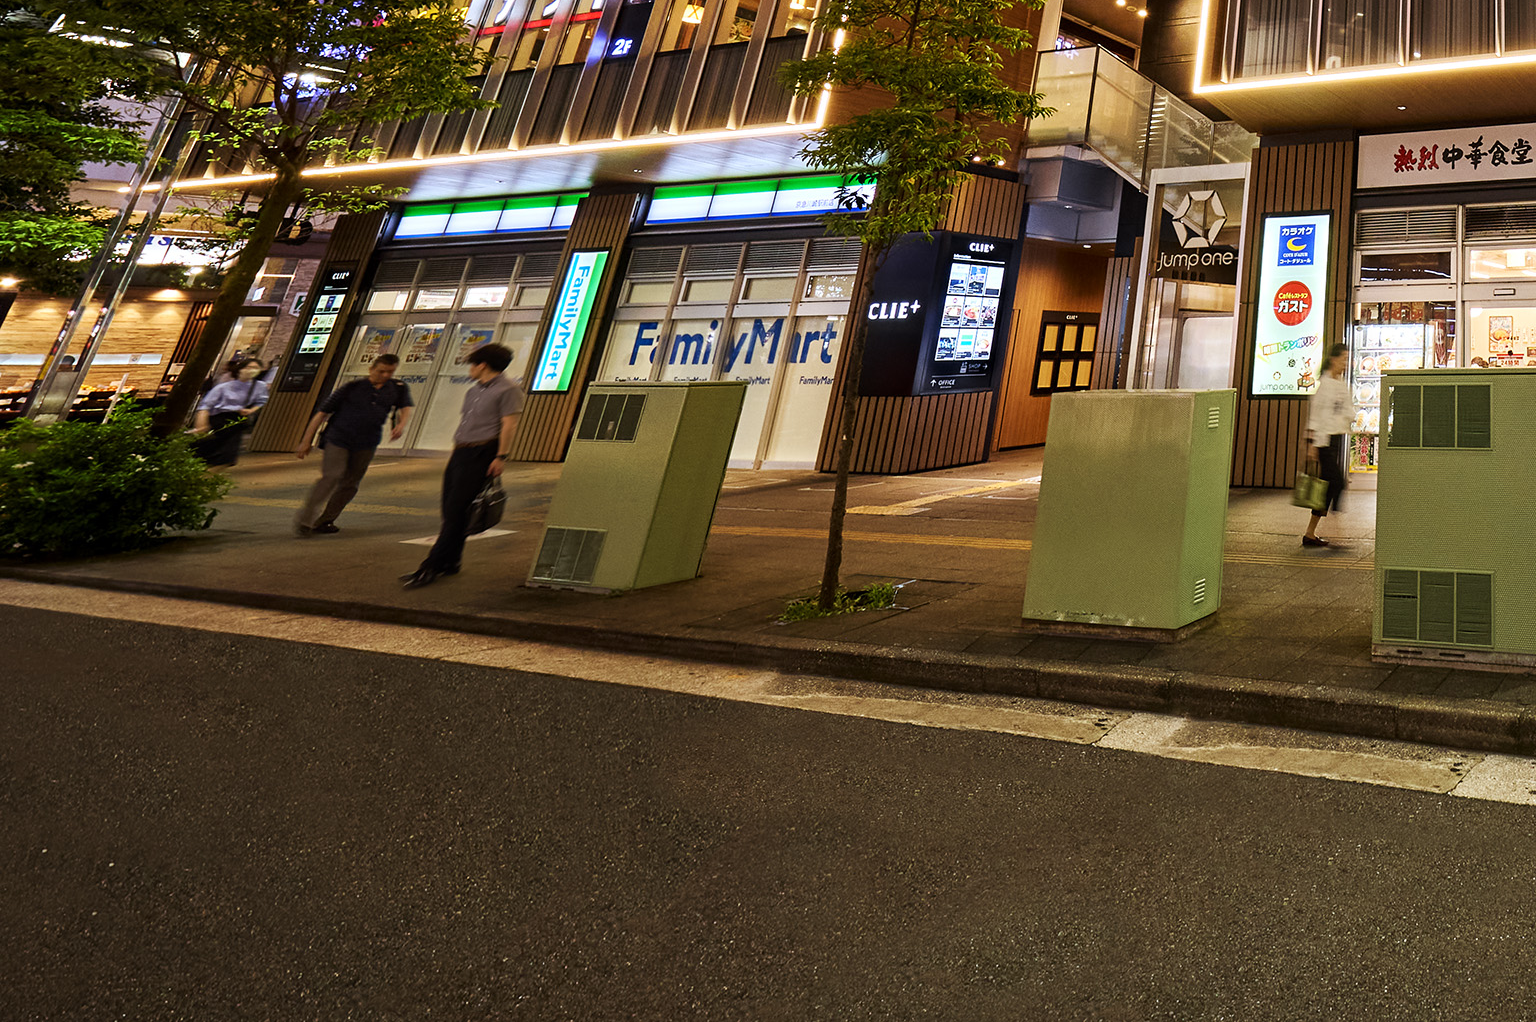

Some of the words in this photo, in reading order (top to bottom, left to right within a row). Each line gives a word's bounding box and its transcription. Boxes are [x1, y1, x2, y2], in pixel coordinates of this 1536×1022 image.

[611, 38, 633, 56] 2F
[1281, 227, 1313, 236] カラオケ
[868, 299, 921, 320] CLIE+
[1278, 299, 1308, 313] ガスト
[545, 266, 590, 379] FamilyMart
[799, 376, 834, 385] FamilyMar
[938, 379, 956, 387] OFFICE
